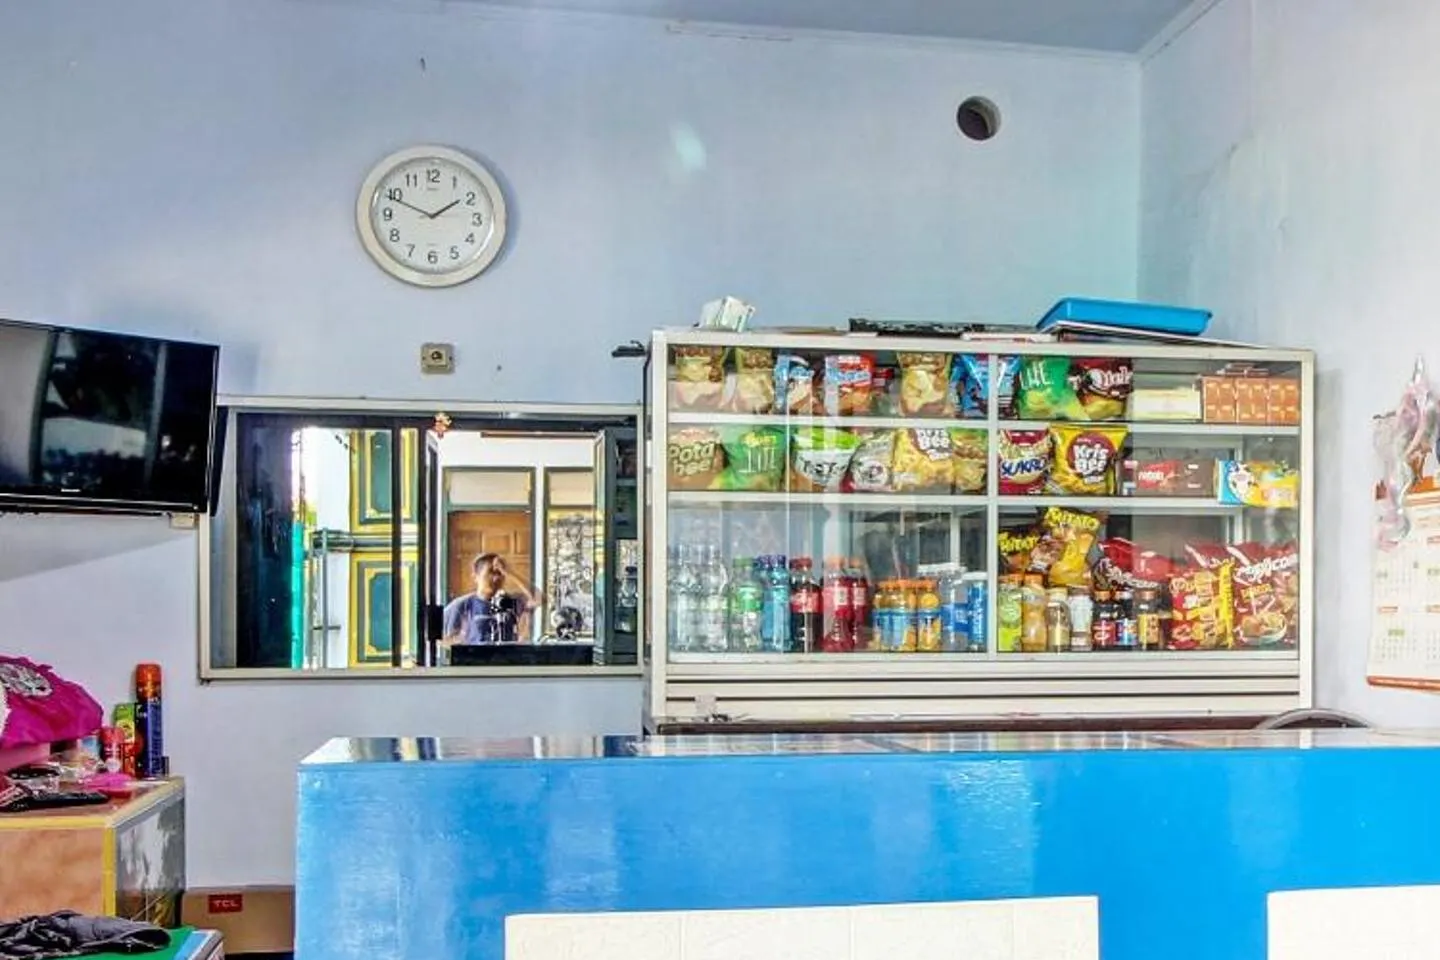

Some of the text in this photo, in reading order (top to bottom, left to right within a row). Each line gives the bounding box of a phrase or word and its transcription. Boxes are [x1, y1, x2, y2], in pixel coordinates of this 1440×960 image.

[405, 173, 418, 188] 11
[426, 169, 441, 183] 12
[386, 188, 403, 202] 10
[465, 191, 476, 206] 2
[383, 207, 393, 221] 9
[471, 212, 483, 227] 3
[389, 228, 400, 242] 8
[464, 233, 475, 244] 4
[406, 244, 416, 258] 7
[427, 250, 438, 264] 6
[450, 246, 460, 260] 5
[213, 899, 239, 908] TCL
